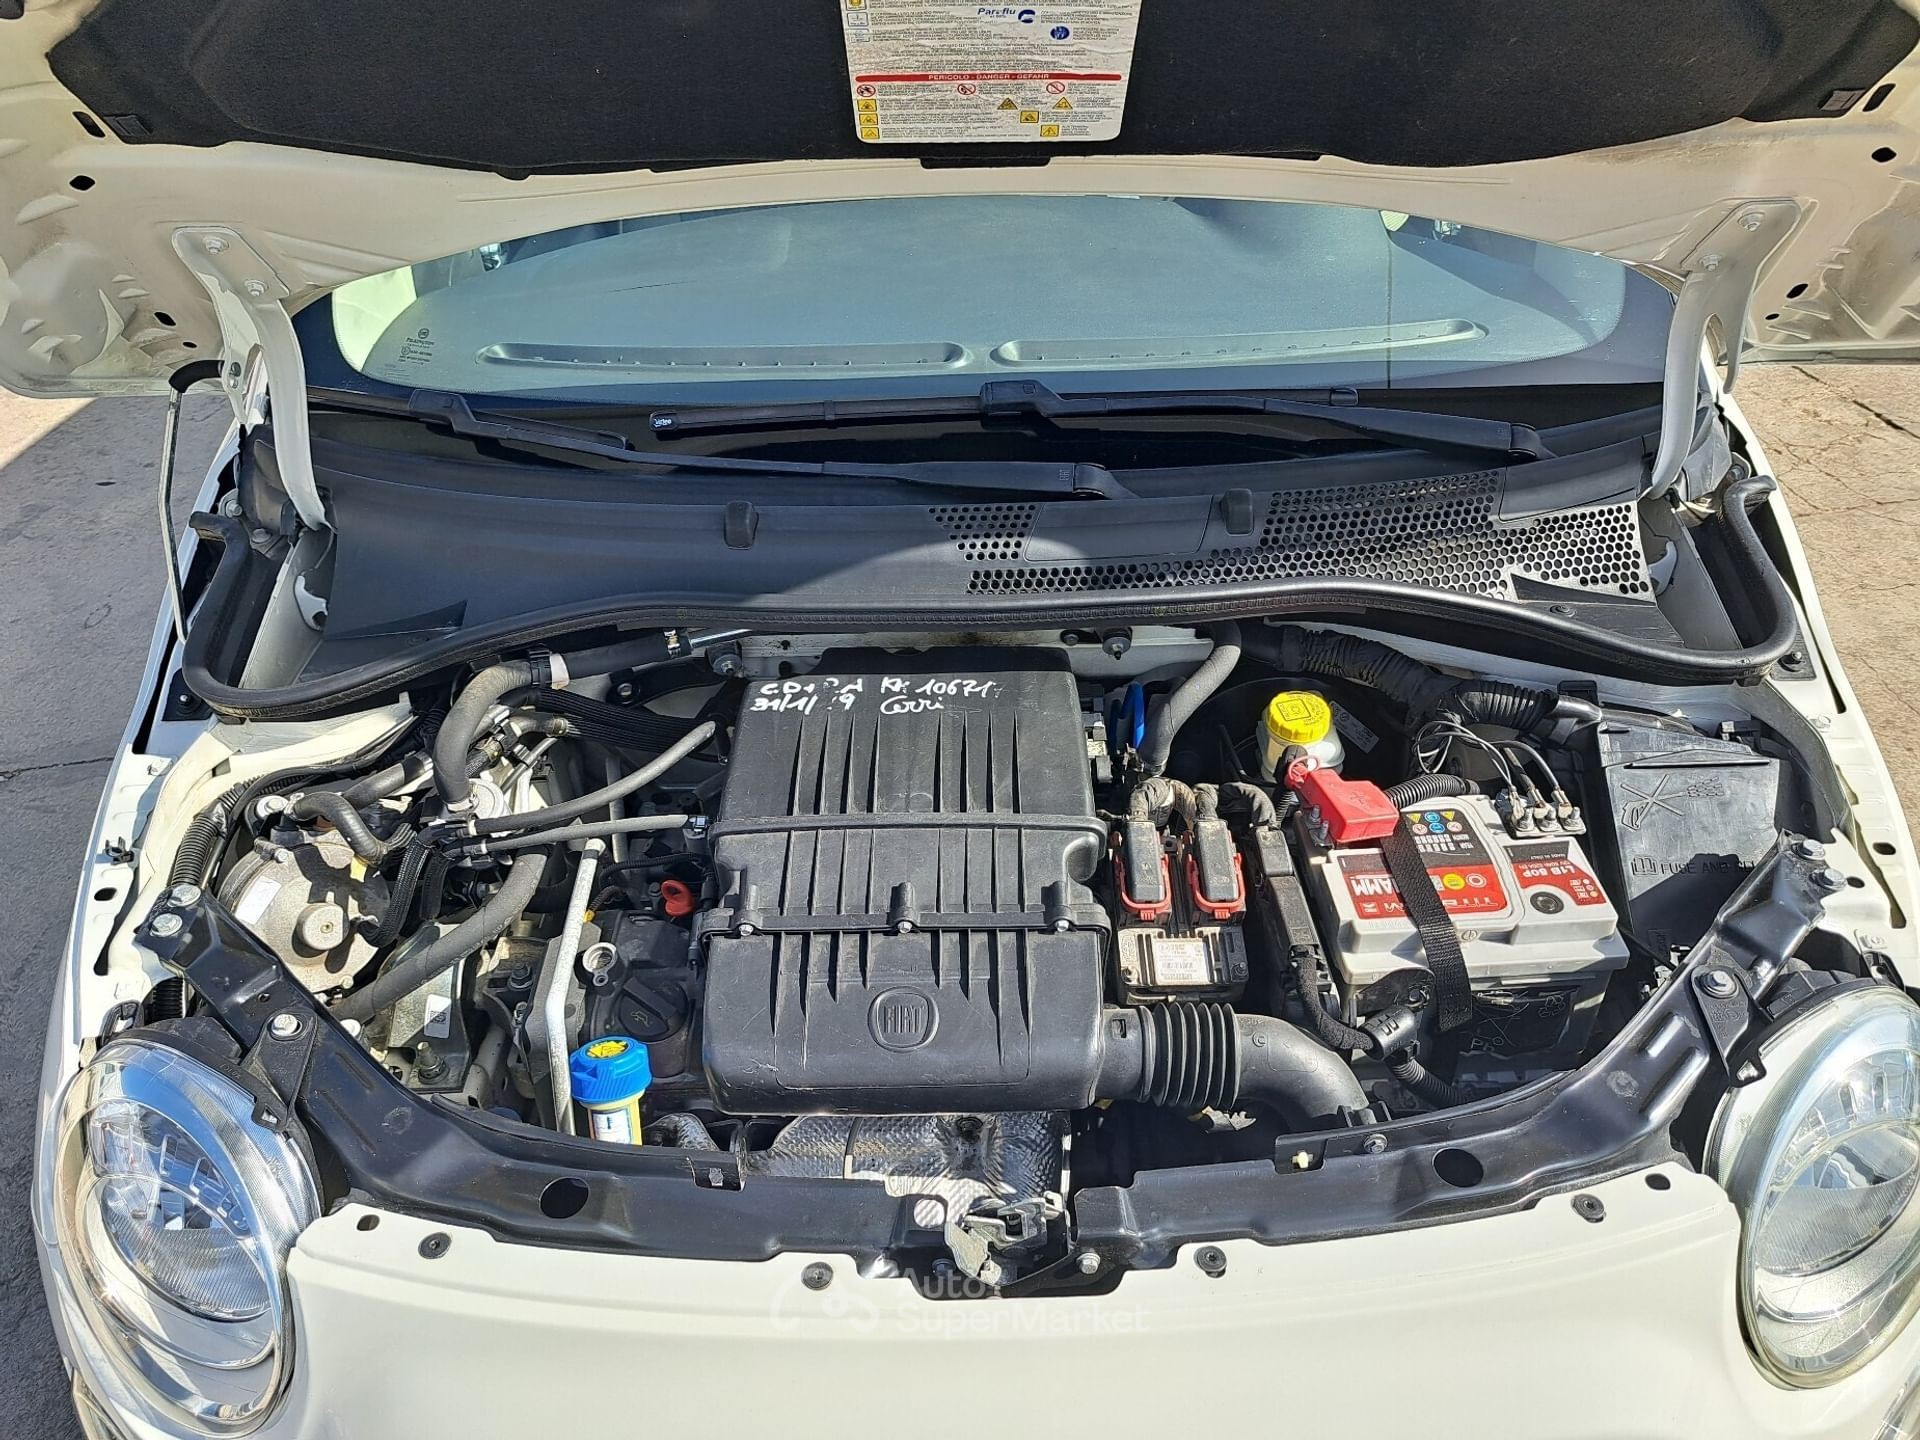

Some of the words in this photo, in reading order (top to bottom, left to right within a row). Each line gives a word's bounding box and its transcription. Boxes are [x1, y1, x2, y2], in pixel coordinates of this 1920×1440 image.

[1660, 862, 1697, 875] FUSE
[1702, 861, 1729, 874] AND
[1350, 878, 1400, 897] IAMM
[883, 1004, 925, 1034] FIAT
